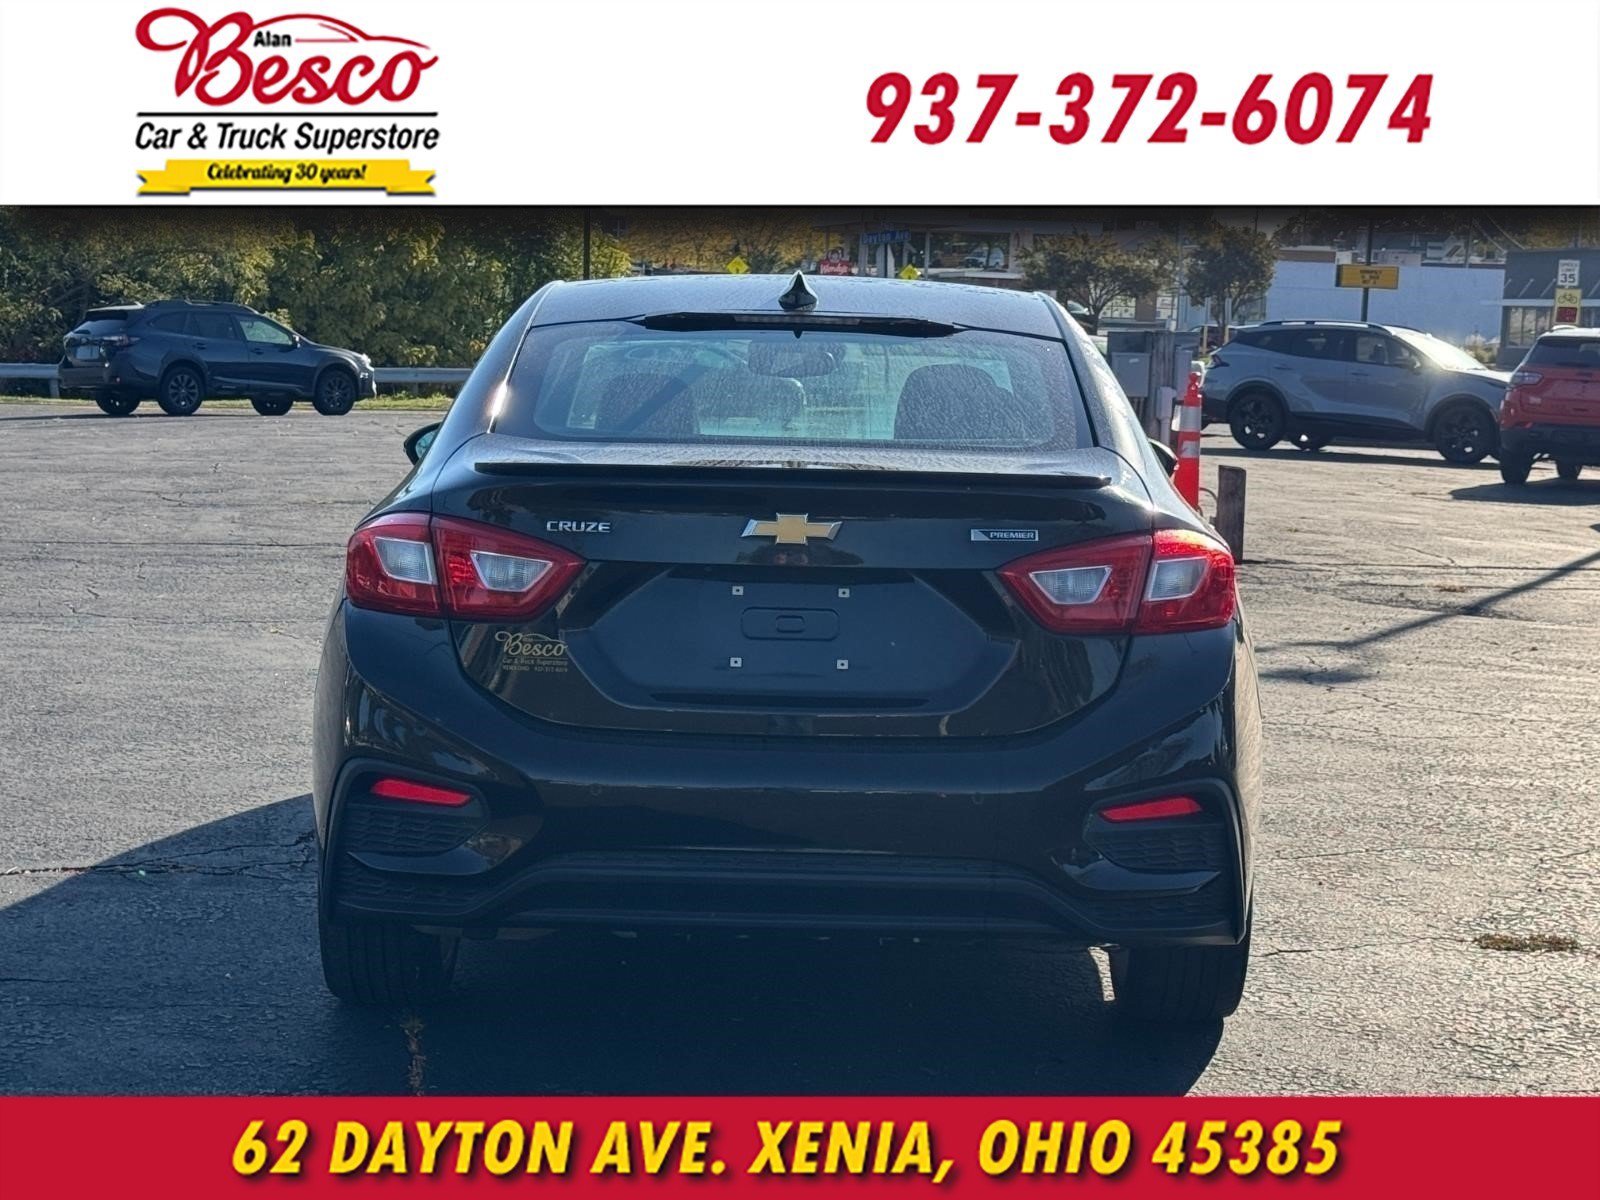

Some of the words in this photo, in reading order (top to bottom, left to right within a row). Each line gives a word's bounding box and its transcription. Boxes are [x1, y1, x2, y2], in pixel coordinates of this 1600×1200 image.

[1560, 273, 1576, 284] 35
[546, 520, 611, 533] CRUZE
[990, 531, 1034, 539] PREMIER
[494, 631, 569, 656] Besco
